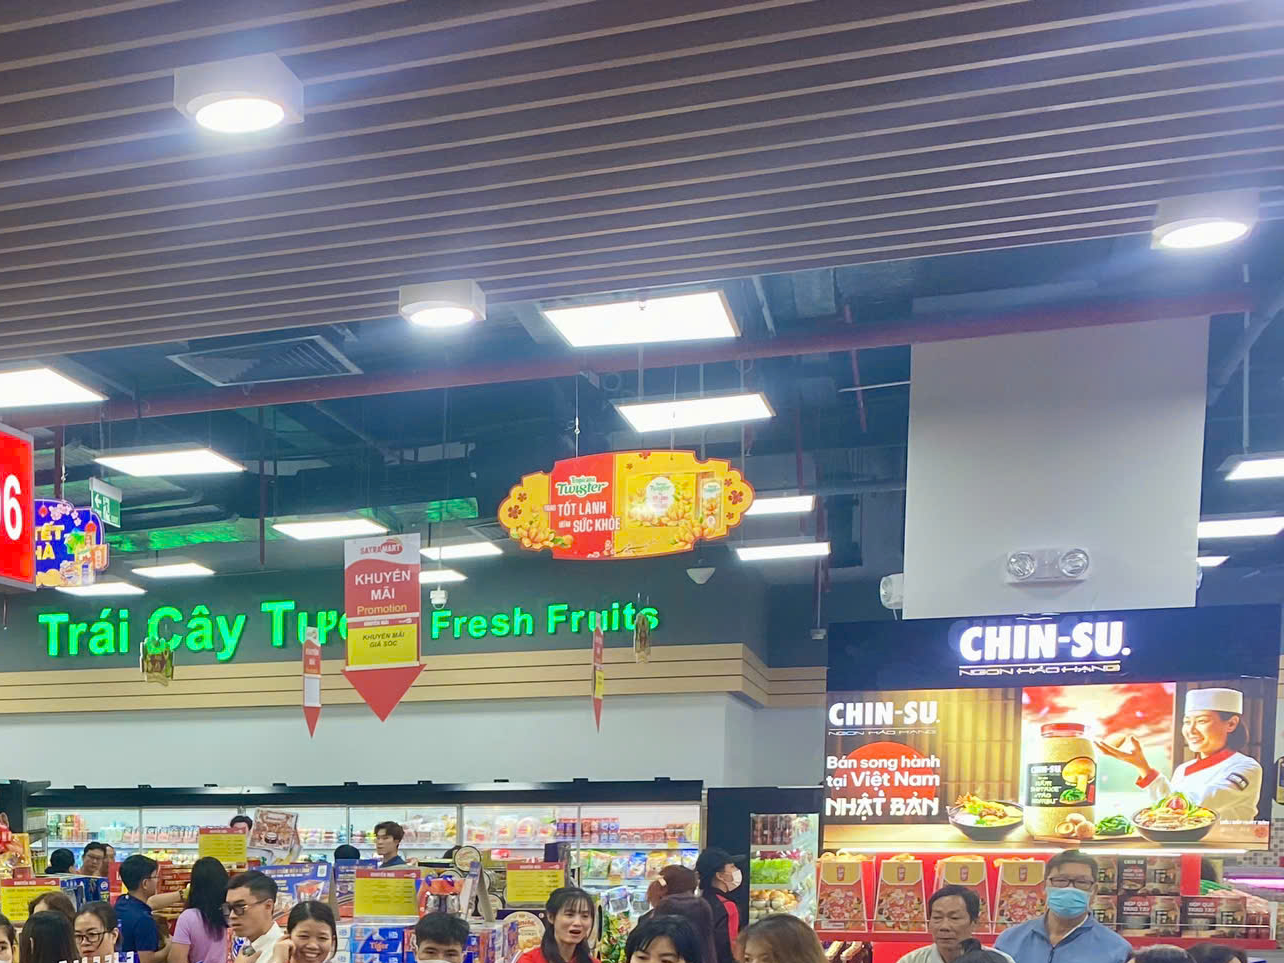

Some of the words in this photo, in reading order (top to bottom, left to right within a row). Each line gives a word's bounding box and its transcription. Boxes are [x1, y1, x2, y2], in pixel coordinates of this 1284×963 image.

[556, 482, 606, 497] Twister
[355, 568, 411, 586] KHUYẾN
[371, 586, 396, 601] MÃI
[357, 603, 408, 616] Promotion
[430, 606, 534, 639] Fresh
[547, 601, 660, 635] Fruits
[37, 608, 129, 657] Trái
[147, 604, 247, 661] Cây
[826, 755, 857, 769] Bán
[859, 758, 897, 772] song
[900, 754, 941, 768] hành
[826, 774, 848, 790] tại
[851, 771, 890, 791] Việt
[894, 773, 941, 787] Nam
[825, 793, 887, 821] NHẬT
[889, 791, 939, 817] BẢN
